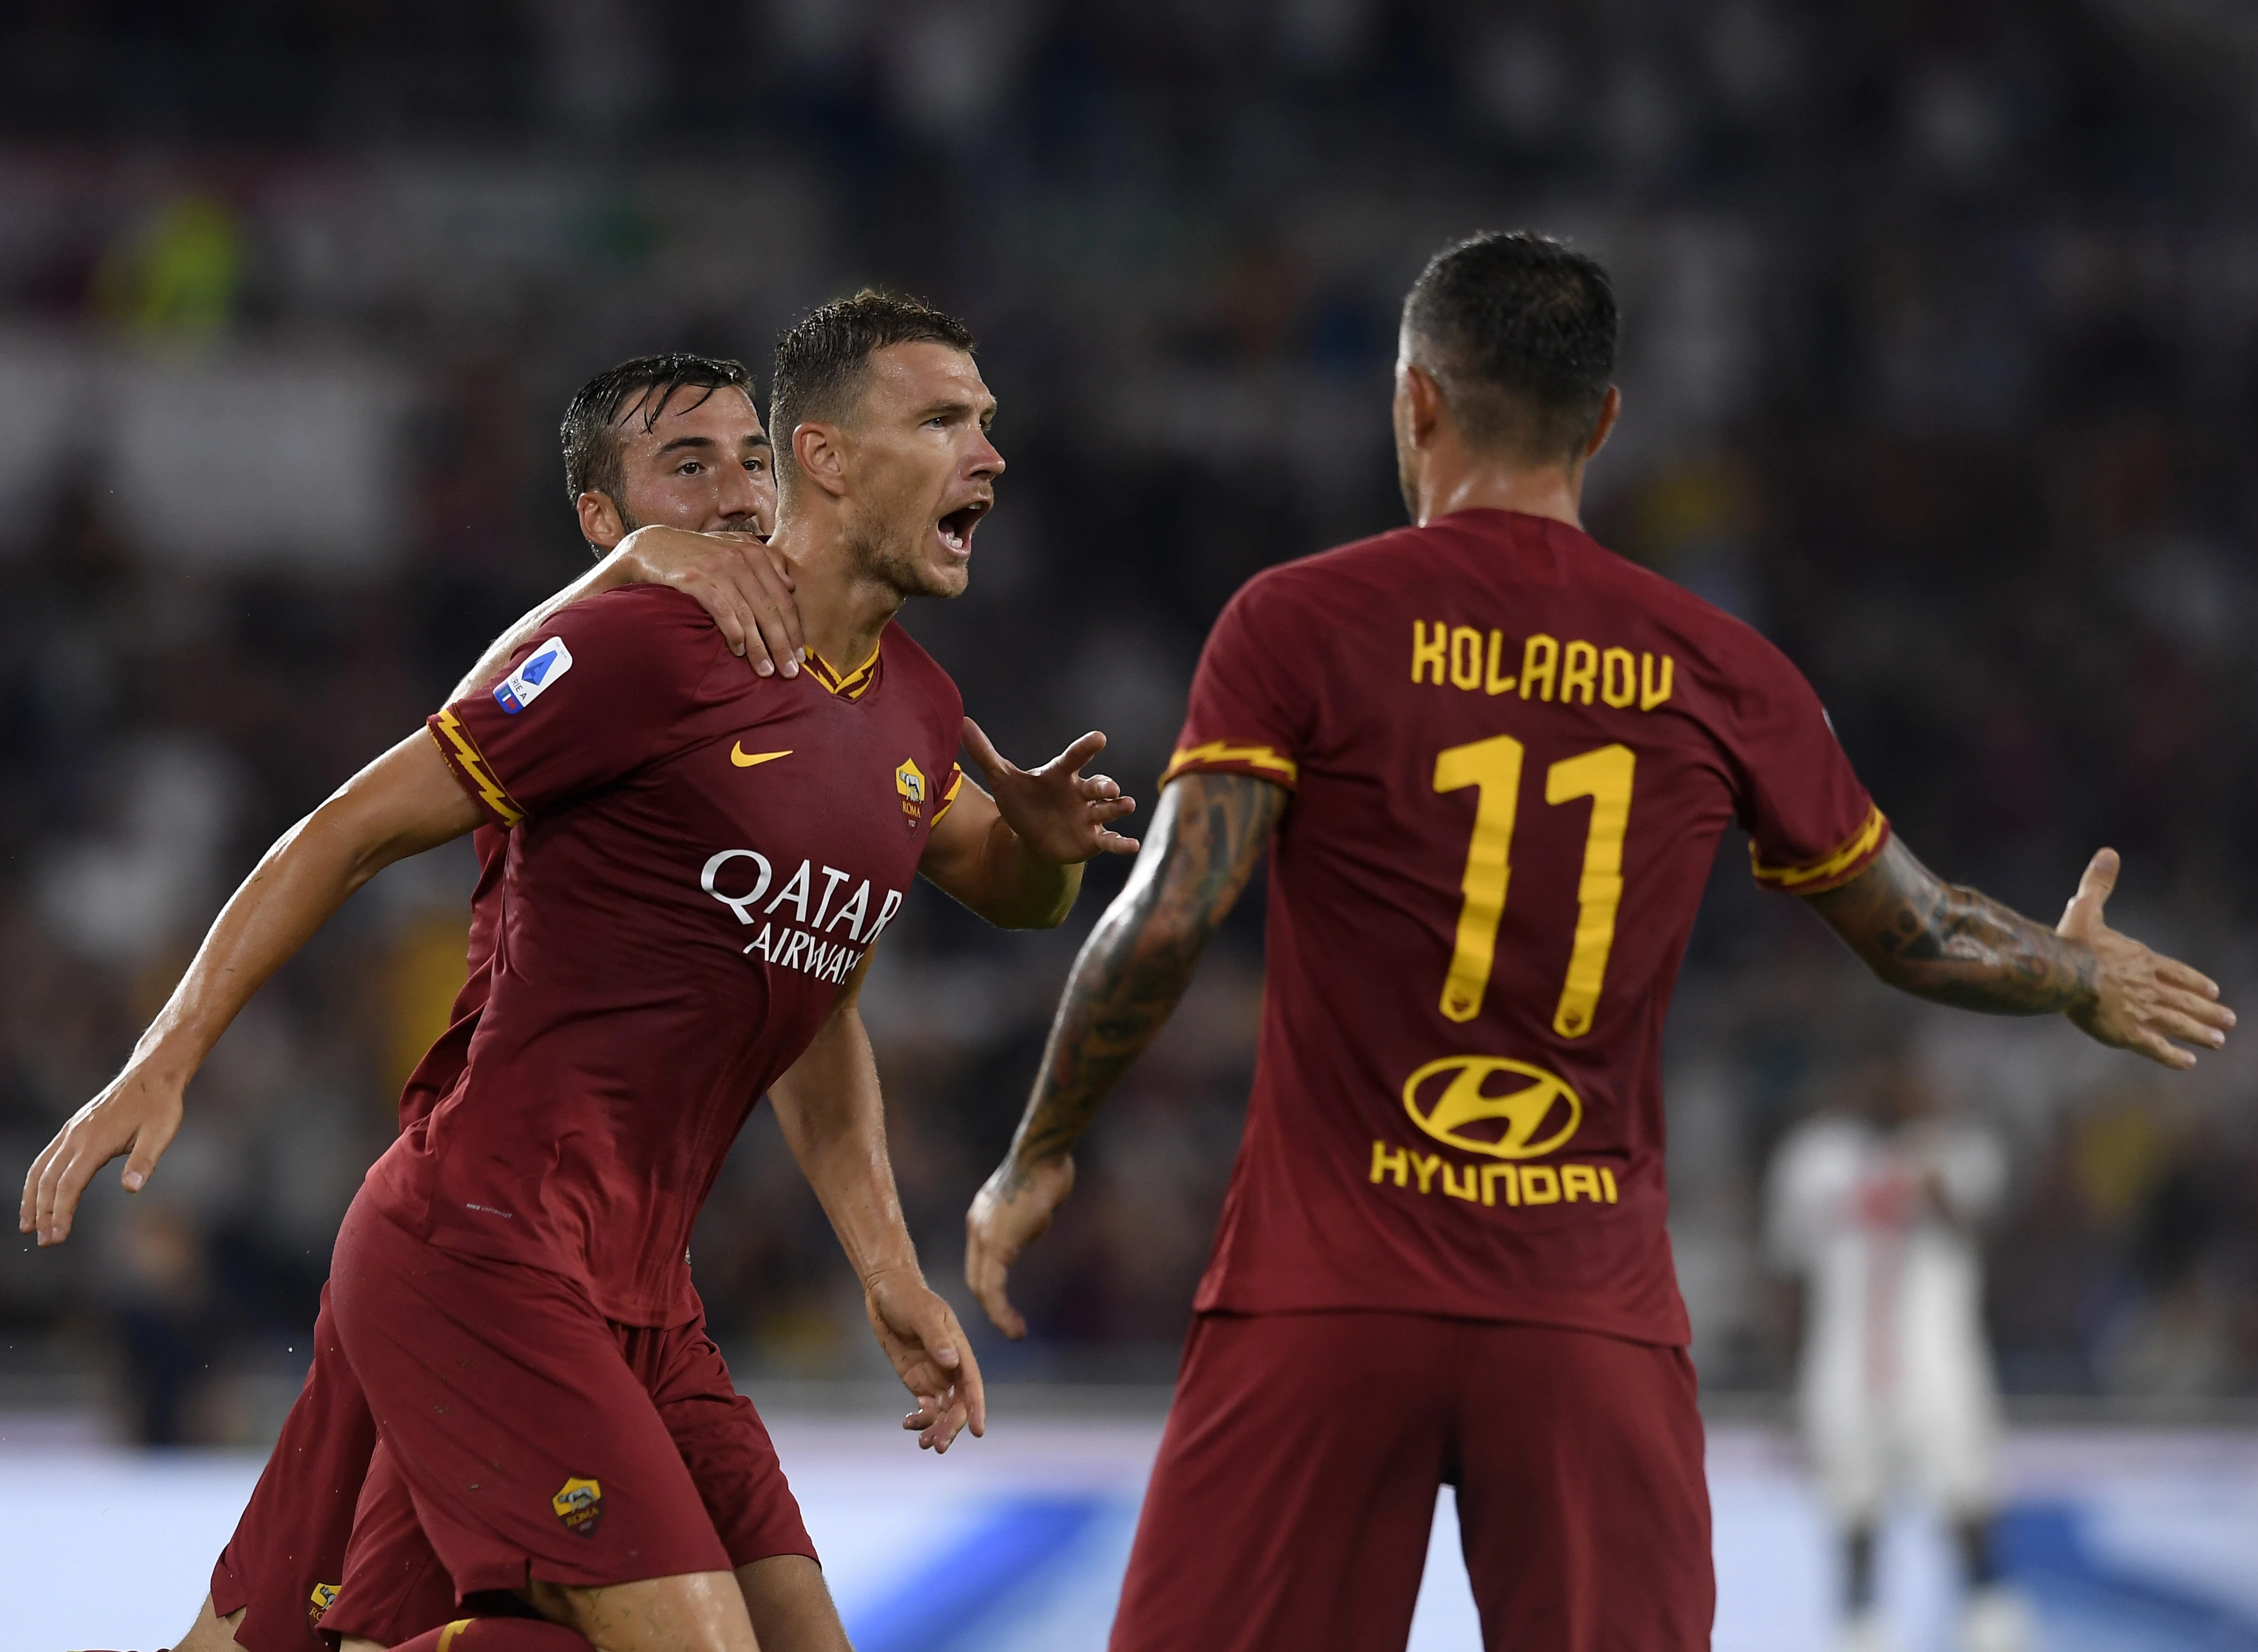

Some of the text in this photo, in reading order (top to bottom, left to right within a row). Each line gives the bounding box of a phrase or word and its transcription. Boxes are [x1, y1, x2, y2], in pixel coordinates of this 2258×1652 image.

[519, 692, 527, 701] A
[1411, 619, 1674, 711] KOLAROV
[500, 686, 518, 711] TIM
[902, 801, 921, 818] ROMA
[701, 849, 903, 945] QATAR
[1433, 734, 1636, 1039] 11
[742, 922, 864, 985] AIRWAY
[1370, 1140, 1618, 1207] HYUNDAI
[566, 1507, 599, 1527] ROMA
